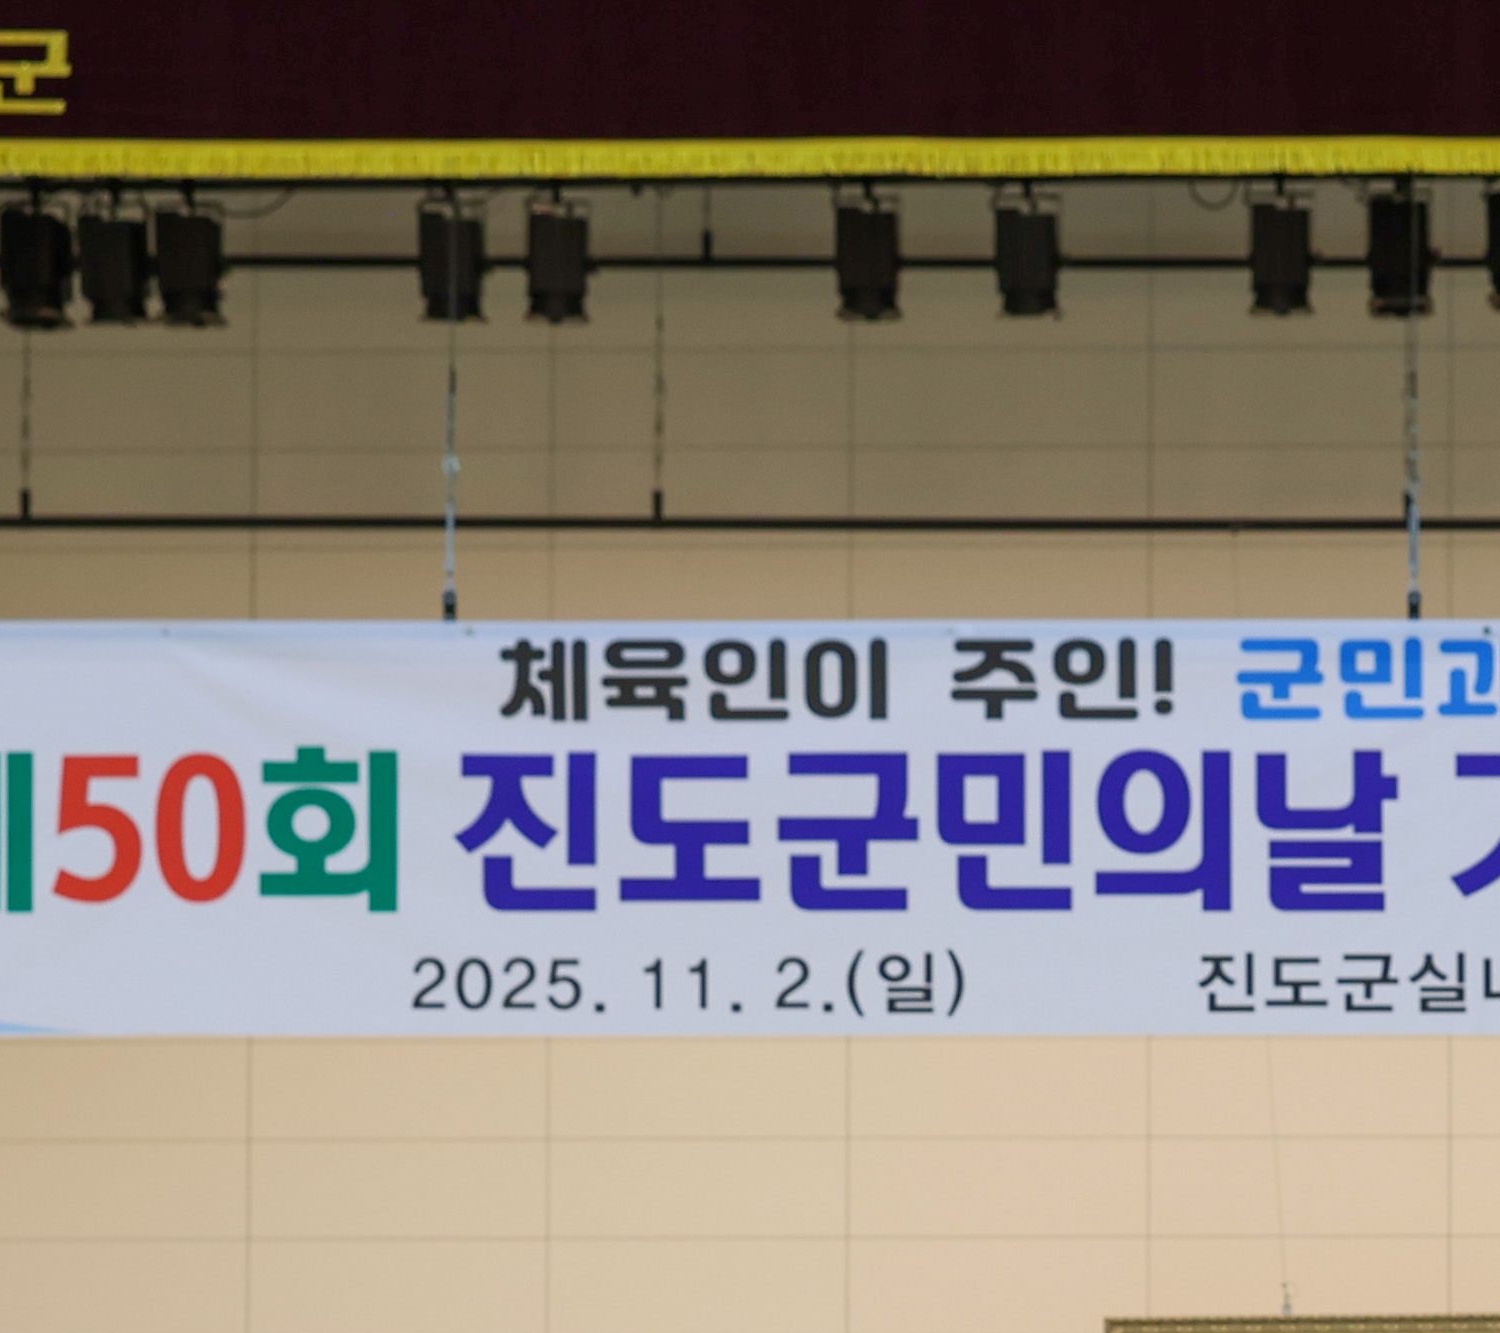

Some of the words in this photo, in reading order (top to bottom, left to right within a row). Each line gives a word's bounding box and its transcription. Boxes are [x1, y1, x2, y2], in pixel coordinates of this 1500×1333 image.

[500, 638, 888, 722] 체육인이
[950, 638, 1174, 721] 주인!
[454, 748, 1399, 912] 진도군민의날
[410, 957, 608, 1012] 2025.
[643, 957, 742, 1012] 11.
